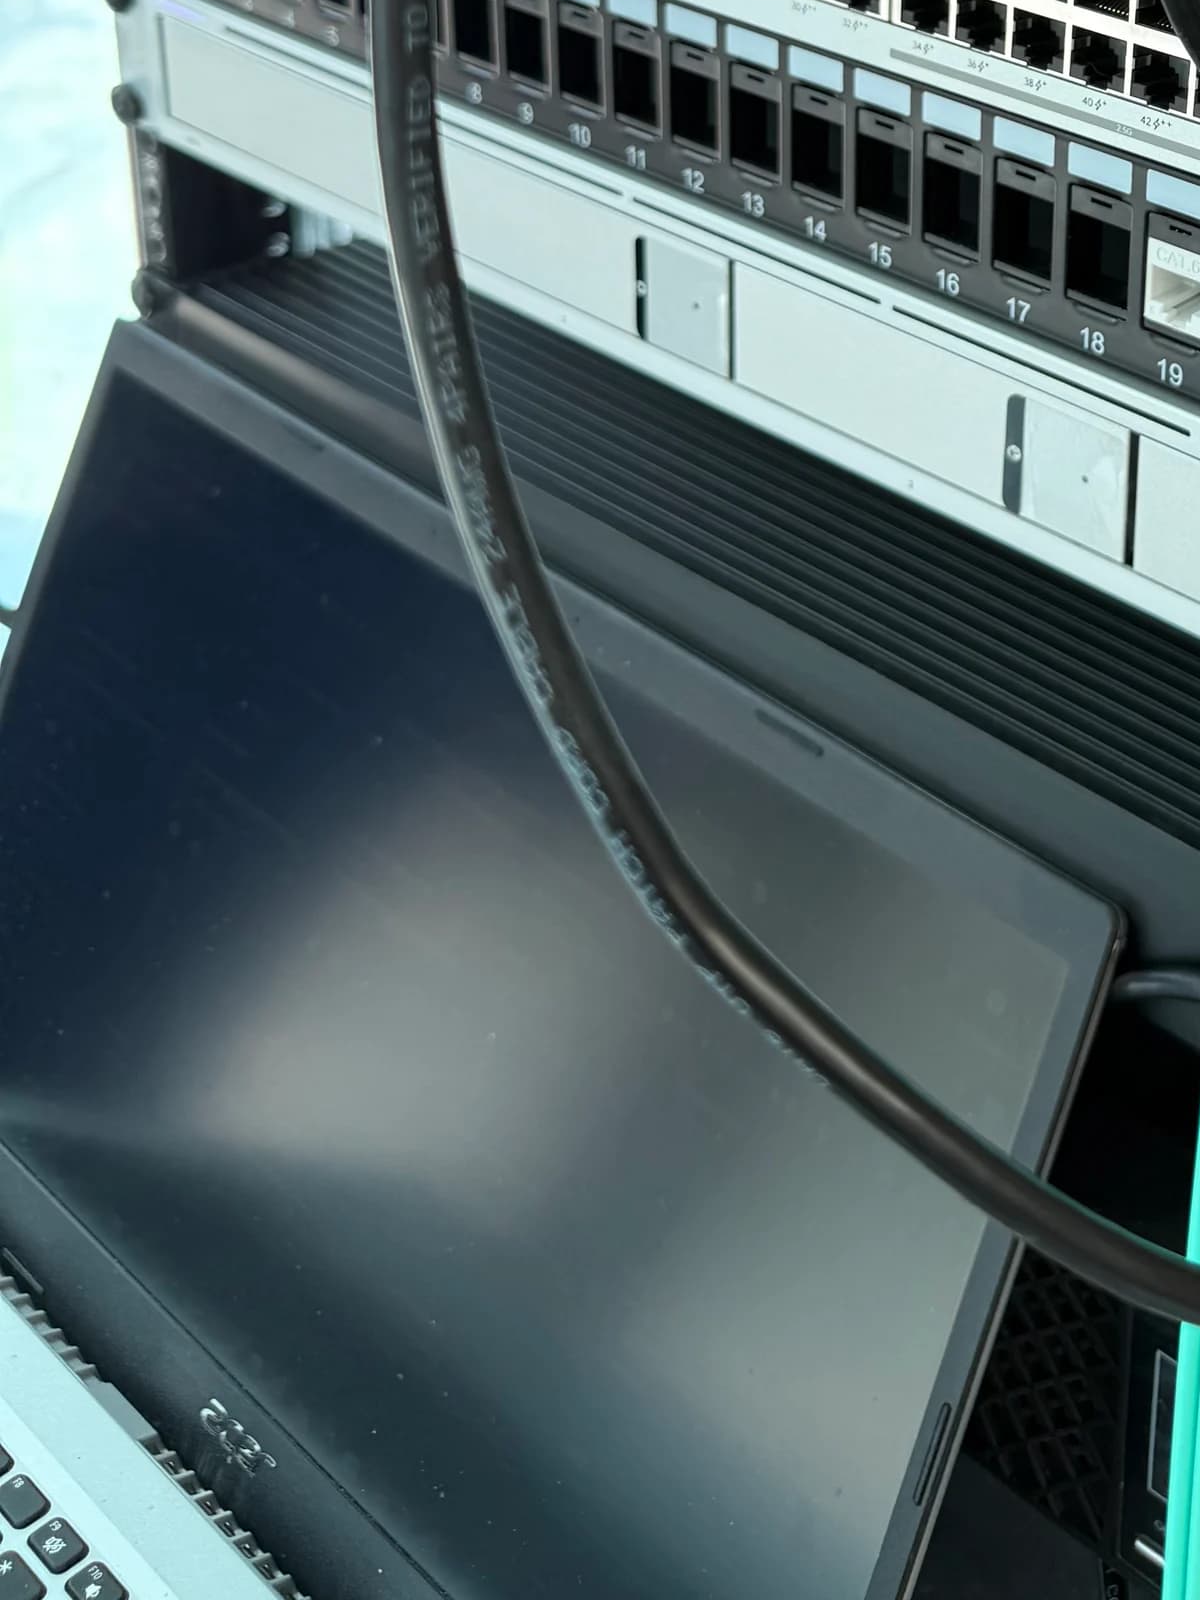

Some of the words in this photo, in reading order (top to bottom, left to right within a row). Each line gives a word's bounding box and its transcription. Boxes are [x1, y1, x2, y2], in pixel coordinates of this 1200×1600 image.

[405, 2, 430, 53] TO
[405, 74, 442, 263] VERIFIED
[465, 82, 483, 105] 8
[516, 100, 535, 125] 9
[567, 122, 592, 148] 10
[624, 144, 647, 170] 11
[680, 167, 705, 195] 12
[741, 191, 765, 218] 13
[802, 215, 828, 243] 14
[867, 240, 893, 269] 15
[934, 267, 961, 297] 16
[1005, 296, 1032, 325] 17
[1079, 326, 1106, 357] 18
[1156, 357, 1184, 388] 19
[200, 1397, 278, 1477] acer
